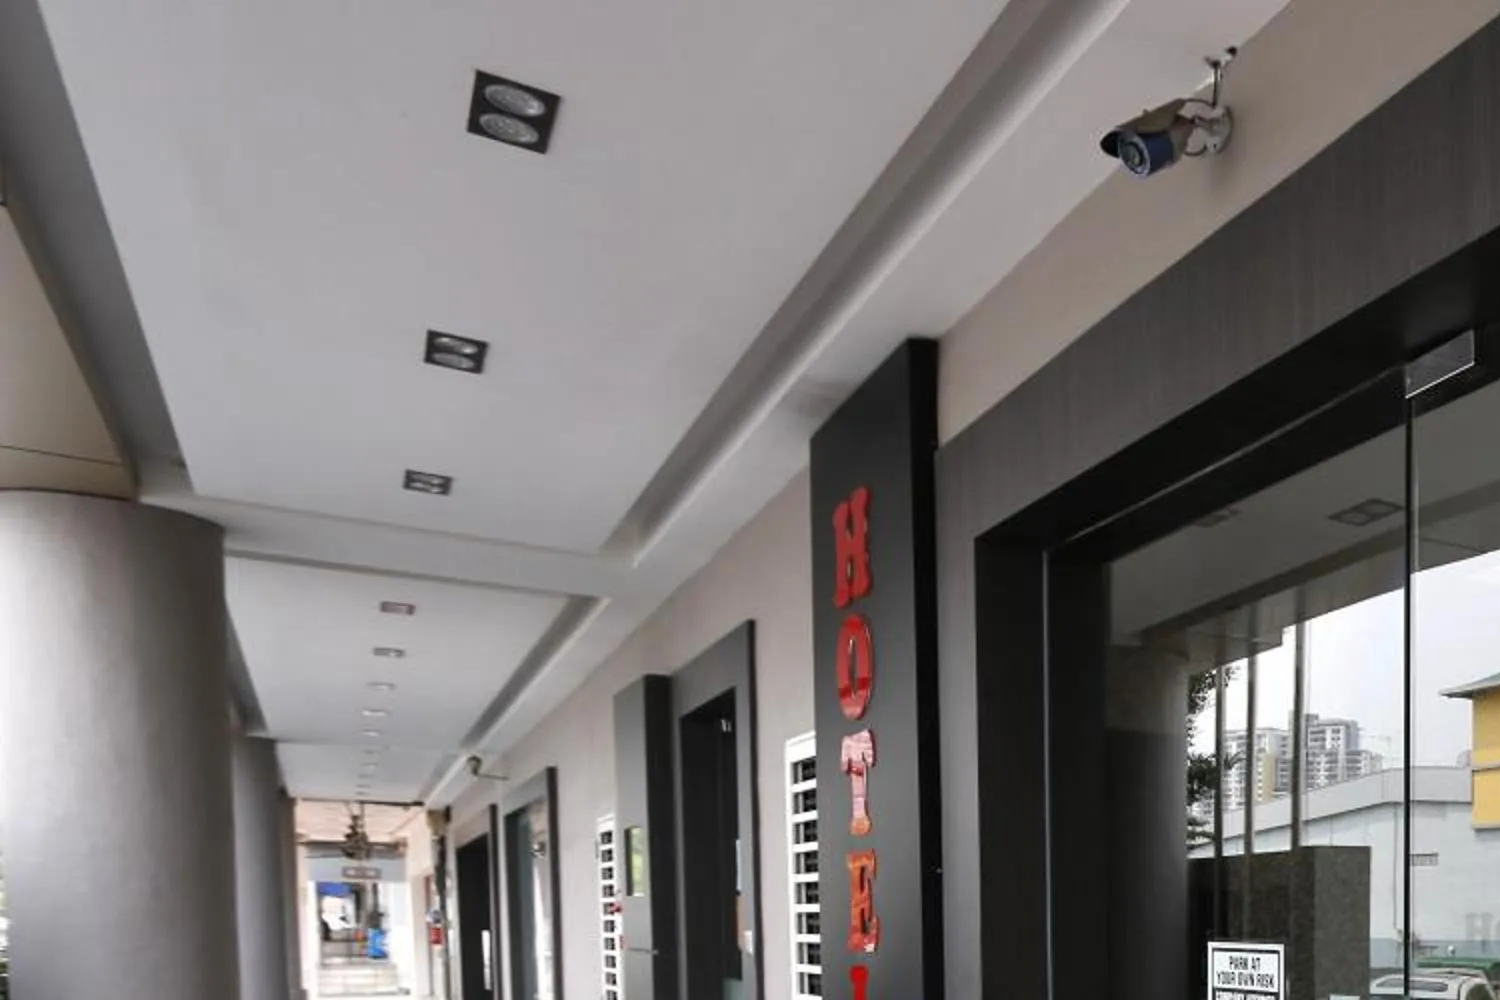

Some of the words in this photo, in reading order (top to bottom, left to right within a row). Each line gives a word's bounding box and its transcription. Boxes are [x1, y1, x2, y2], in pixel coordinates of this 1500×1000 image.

[1229, 955, 1248, 970] PARK
[1252, 956, 1261, 971] AT
[1216, 970, 1236, 984] YOUR
[1238, 971, 1254, 986] OWN
[1256, 973, 1275, 989] RISK
